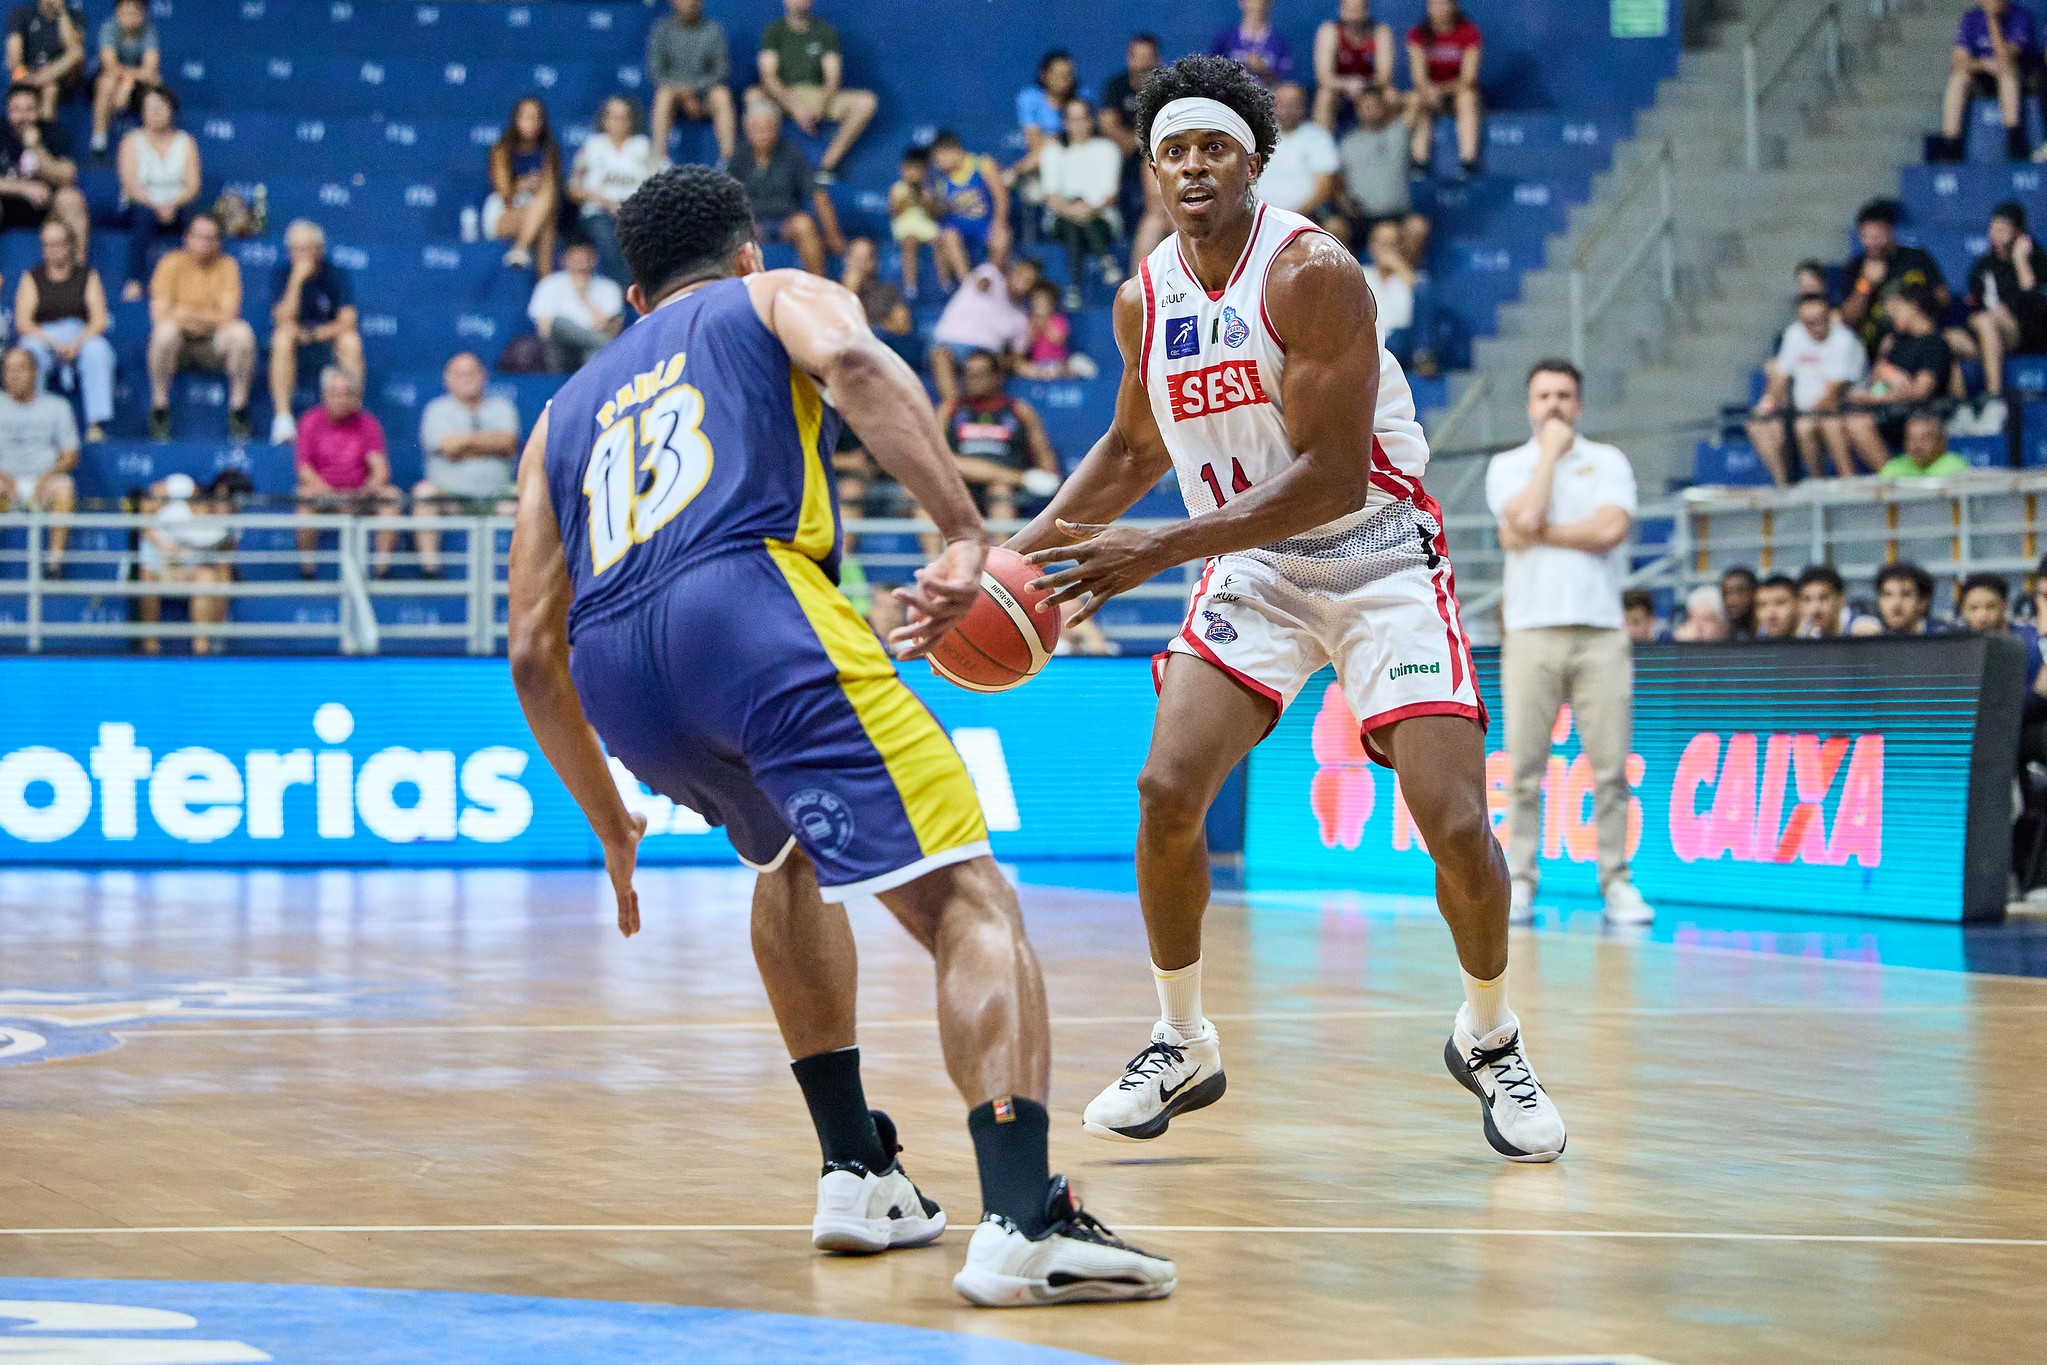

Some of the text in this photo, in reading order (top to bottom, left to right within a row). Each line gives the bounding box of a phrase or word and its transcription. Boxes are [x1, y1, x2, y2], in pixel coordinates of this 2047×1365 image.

[1181, 366, 1256, 414] SESI
[582, 384, 714, 577] 13
[1390, 662, 1440, 680] Unimed
[0, 703, 533, 843] oterias
[1668, 732, 1885, 868] CAIXA
